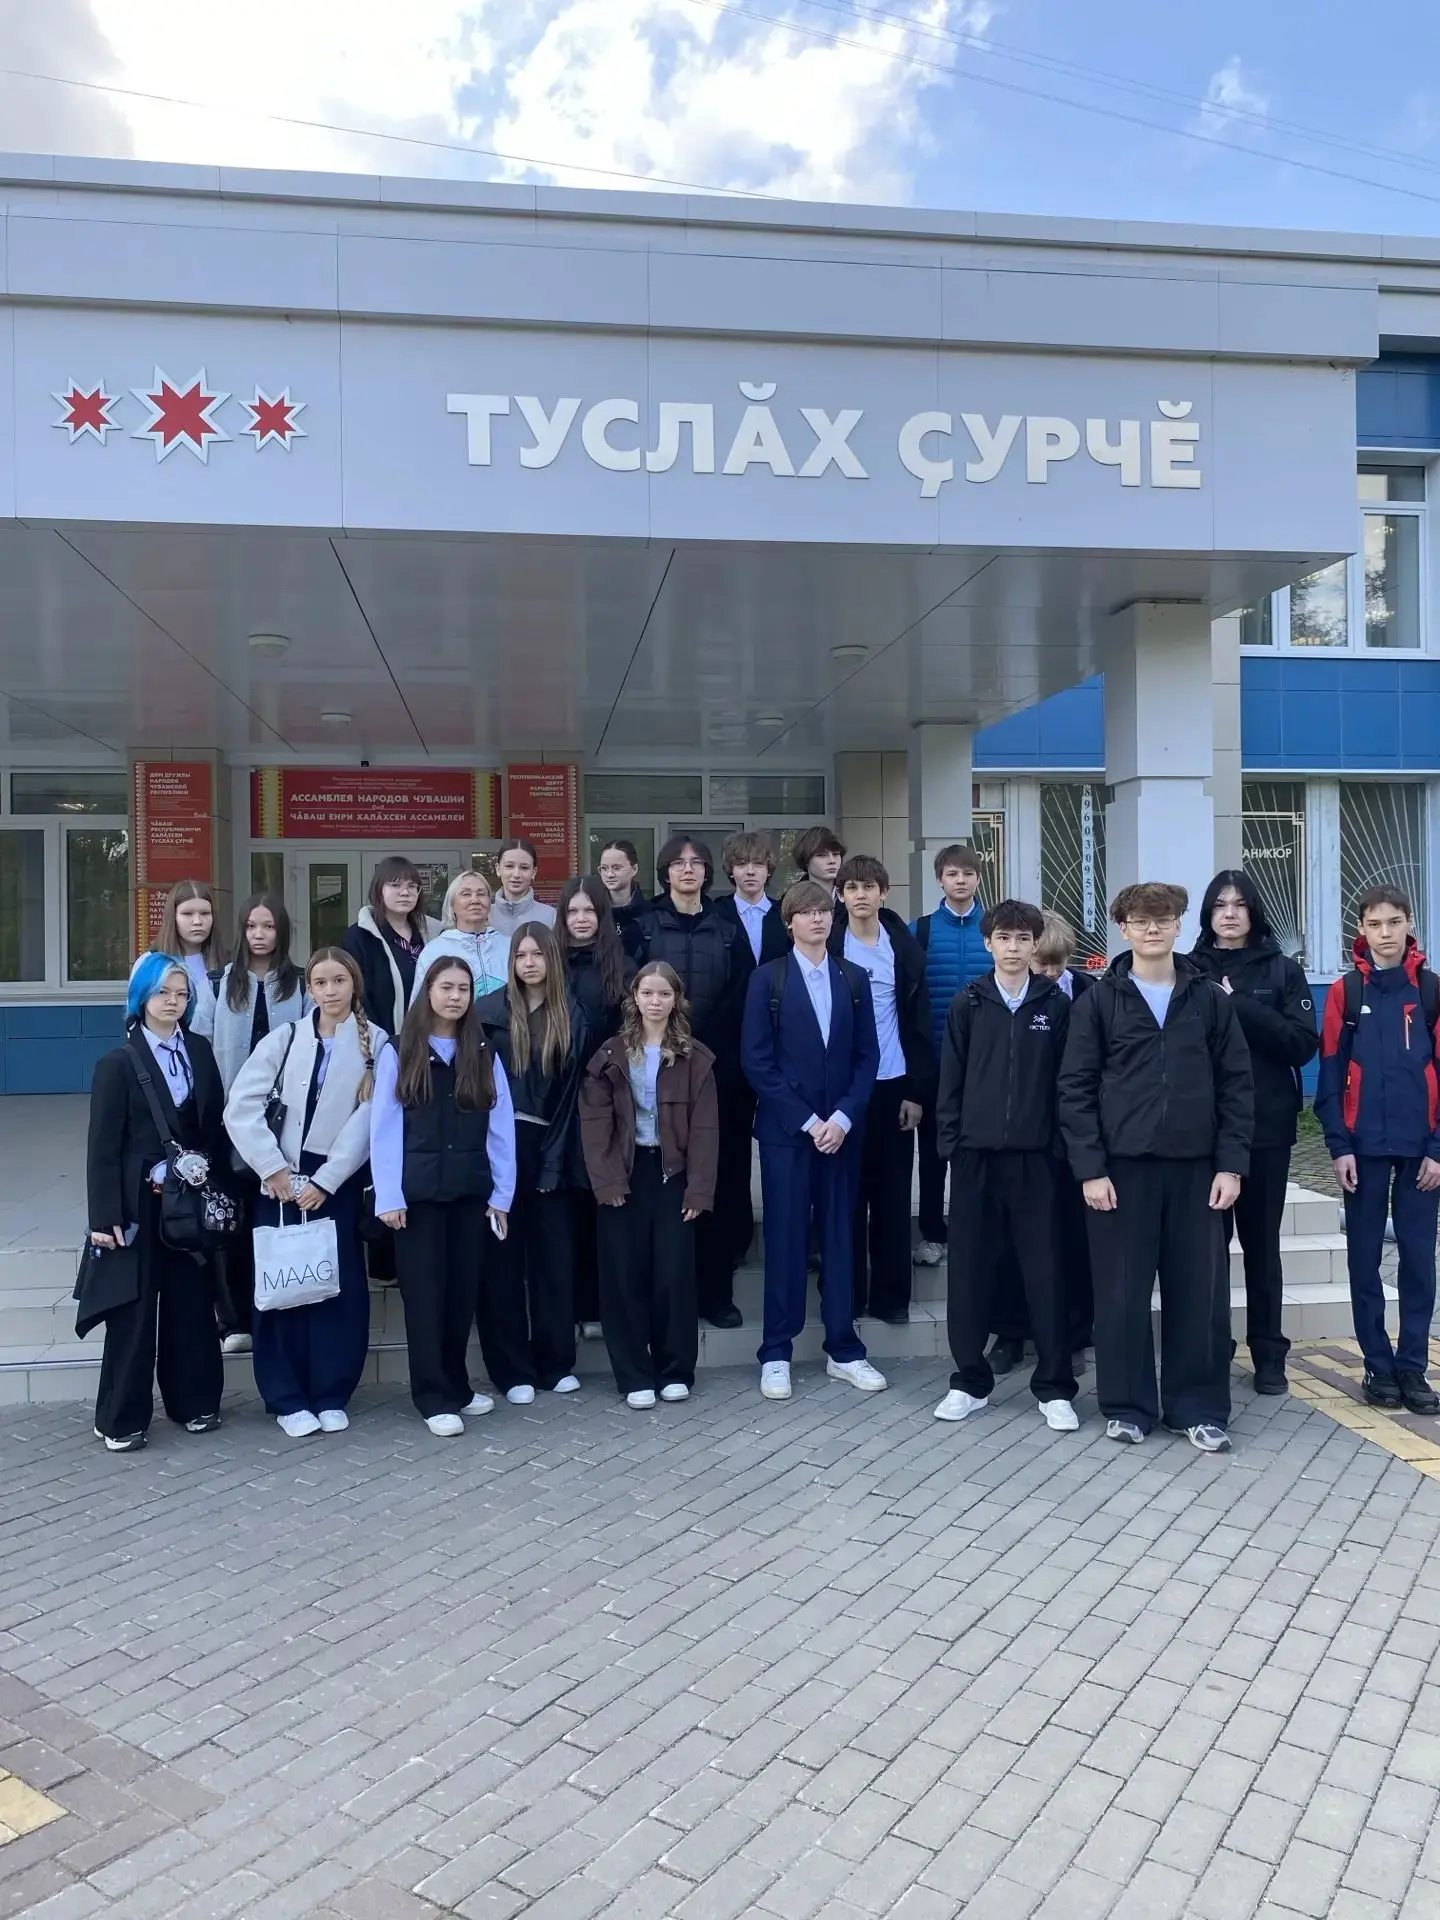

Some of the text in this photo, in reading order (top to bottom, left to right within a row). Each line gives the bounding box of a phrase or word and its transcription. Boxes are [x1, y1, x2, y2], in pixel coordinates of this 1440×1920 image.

[446, 381, 1201, 499] ТУСЛӐХ ҪУРЧӖ
[290, 793, 465, 803] АССАМБЛЕЯ НАРОДОВ ЧУВАШИИ
[290, 811, 325, 820] ЧӐВАШ
[328, 813, 353, 821] ЕНРИ
[357, 812, 407, 821] ХАЛӐХСЕН
[1241, 848, 1293, 859] АНИКЮР
[263, 1260, 333, 1291] MAAG
